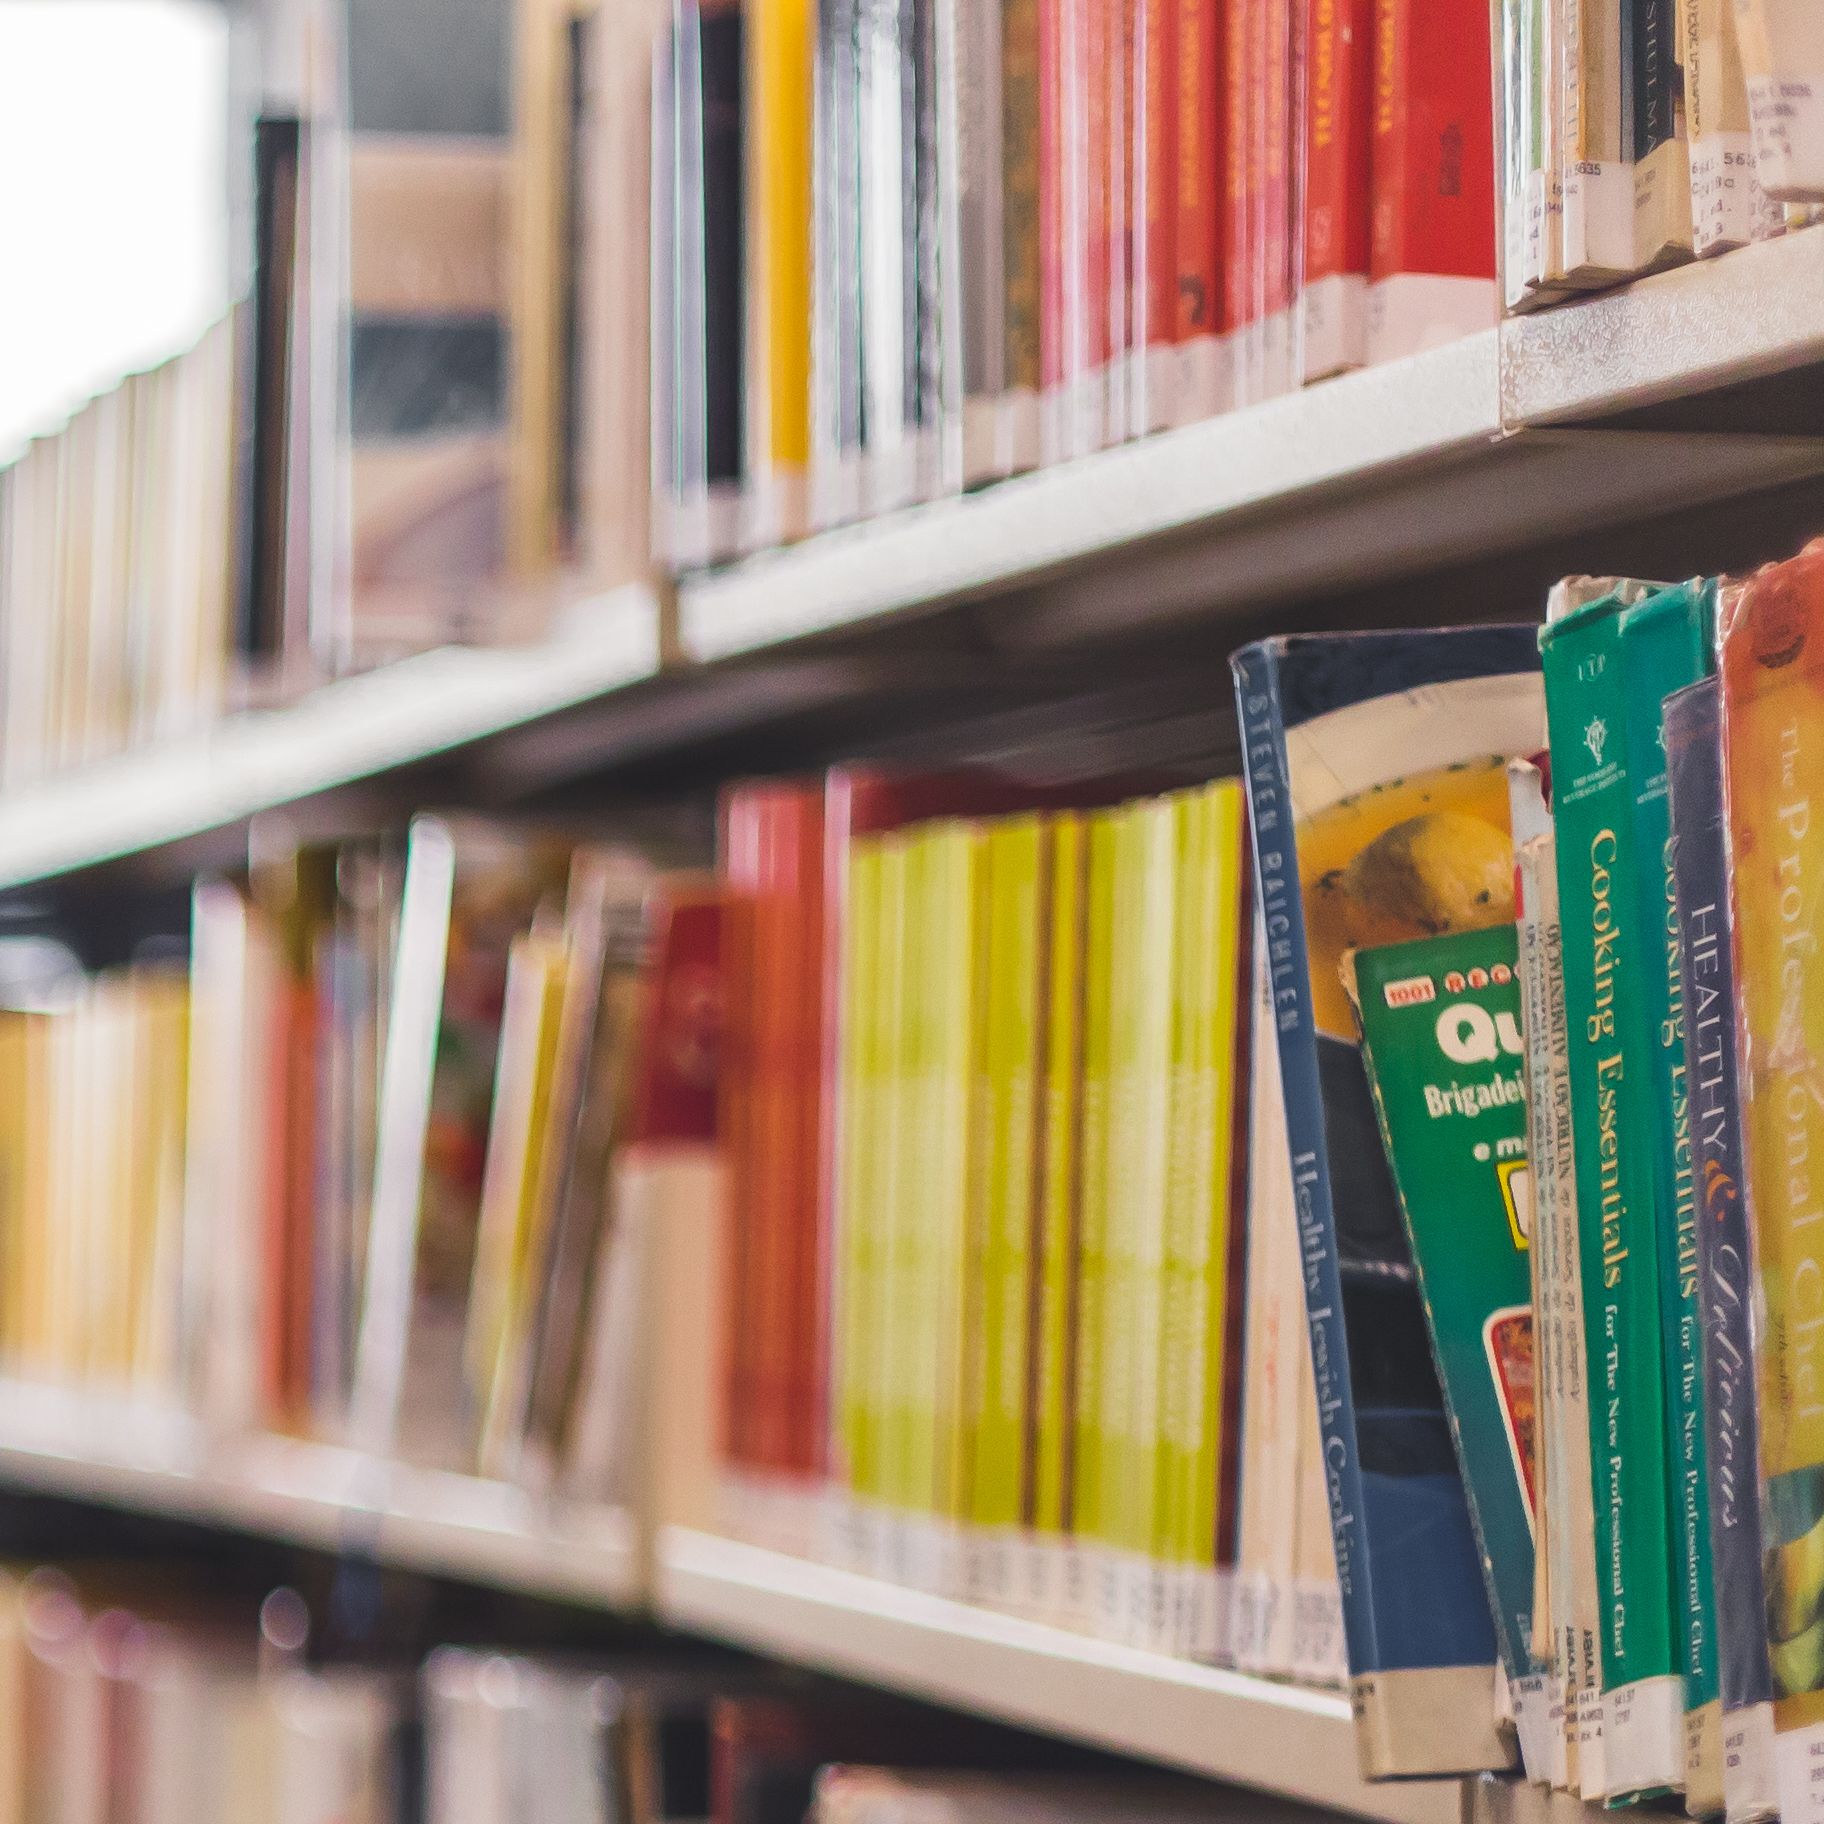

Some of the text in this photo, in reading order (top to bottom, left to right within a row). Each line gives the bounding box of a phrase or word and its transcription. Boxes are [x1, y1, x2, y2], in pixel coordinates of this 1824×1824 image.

[1779, 717, 1800, 786] The
[1245, 692, 1300, 1034] STEVEN RAICHLEN
[1388, 964, 1520, 1005] 1001 REC
[1691, 903, 1727, 1153] HEALTHY
[1293, 1151, 1328, 1296] Healthy
[1587, 828, 1628, 1658] Cooking Essentials for The New Professional Chef
[1309, 1306, 1343, 1426] Jewish
[1680, 1314, 1693, 1350] for
[1682, 1356, 1696, 1403] The
[1683, 1409, 1697, 1462] New
[1686, 1469, 1702, 1613] Professional
[1690, 1620, 1703, 1676] Chef
